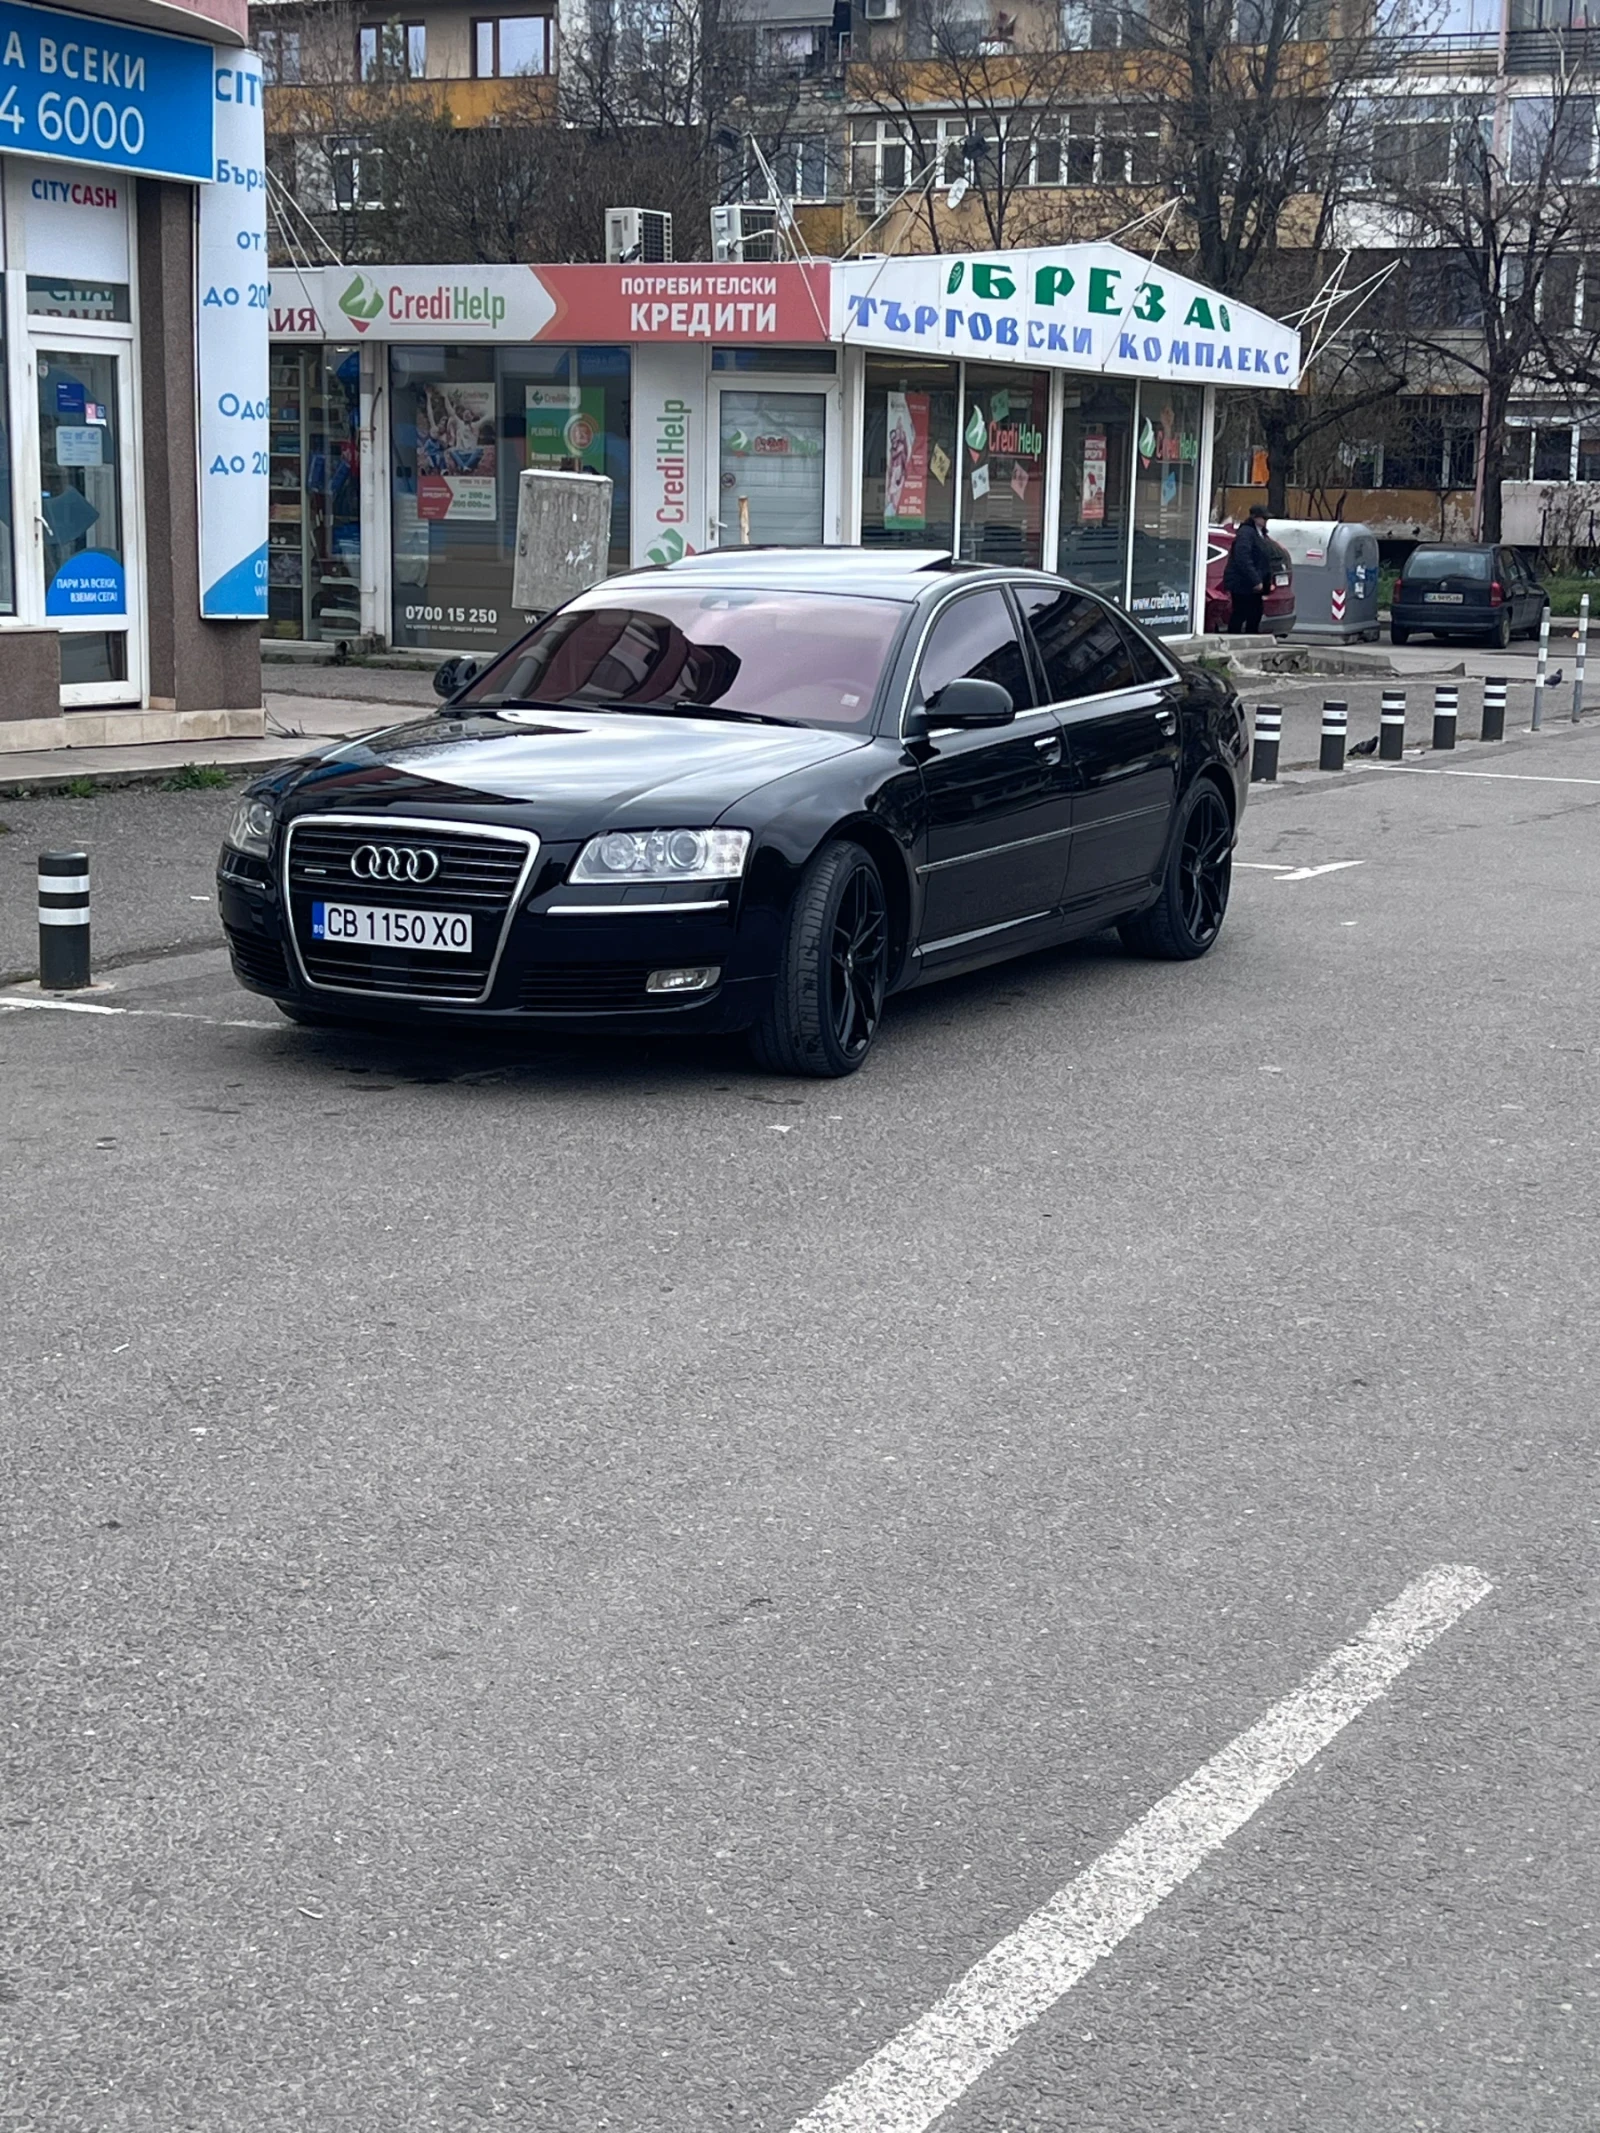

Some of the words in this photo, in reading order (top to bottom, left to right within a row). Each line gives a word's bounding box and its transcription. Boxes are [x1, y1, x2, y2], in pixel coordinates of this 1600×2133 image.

[40, 36, 146, 92] ВСЕКИ
[0, 84, 26, 135] 4
[38, 91, 145, 155] 6000
[31, 178, 117, 209] CITYCASH
[388, 285, 506, 330] CrediHelp
[971, 262, 1216, 331] БРЕЗА
[630, 302, 777, 338] КРЕДИТИ
[847, 294, 1093, 355] ТЪРГОВСКИ
[1118, 332, 1290, 376] КОМПЛЕКС
[656, 399, 693, 524] CrediHelp
[988, 420, 1043, 463] CrediHelp
[405, 605, 443, 621] 0700
[447, 607, 465, 622] 15
[468, 608, 498, 624] 250
[327, 907, 359, 939] CB
[366, 911, 426, 945] 1150
